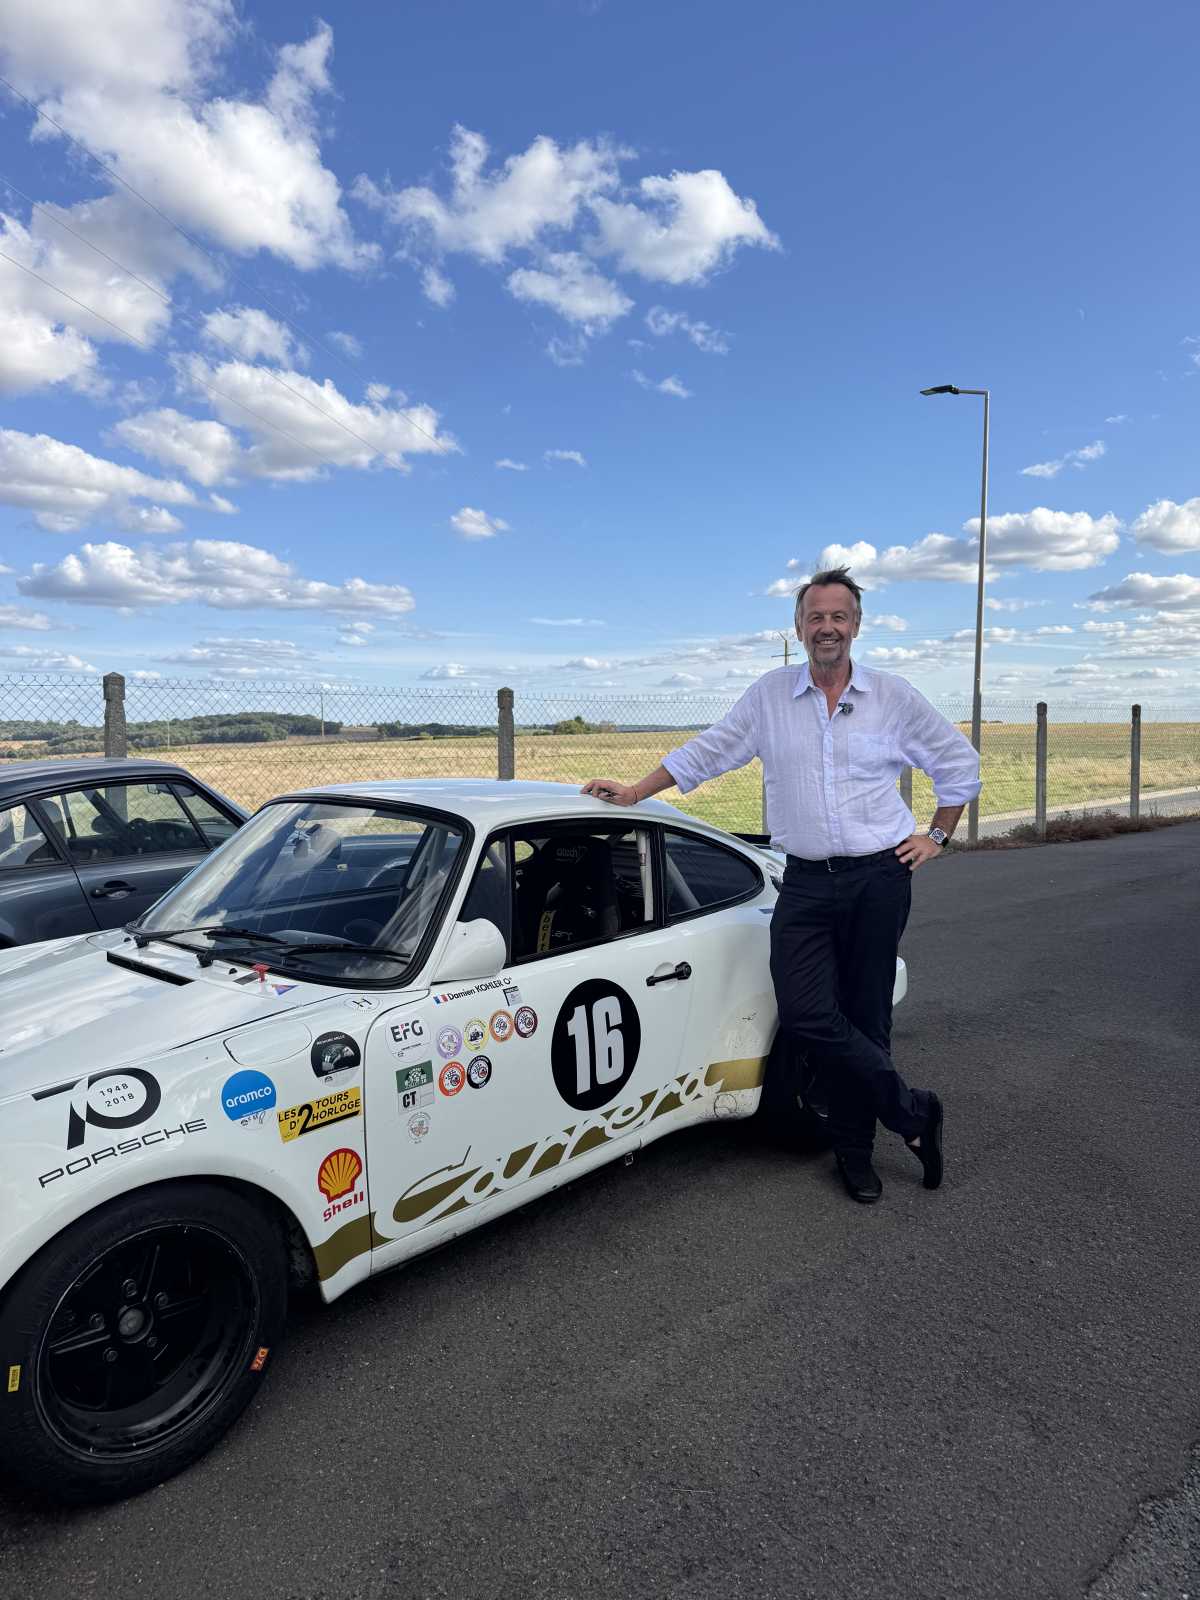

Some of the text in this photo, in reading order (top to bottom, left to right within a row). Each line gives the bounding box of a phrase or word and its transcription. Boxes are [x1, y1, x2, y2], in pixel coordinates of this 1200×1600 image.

[447, 988, 476, 1001] Damien
[475, 979, 503, 993] KOHLER
[390, 1019, 424, 1043] EFG
[567, 995, 625, 1095] 16
[100, 1083, 129, 1097] 1948
[105, 1093, 135, 1108] 2018
[226, 1086, 272, 1108] aramco
[402, 1091, 417, 1109] CT
[31, 1067, 162, 1151] 70
[278, 1109, 297, 1123] LES
[315, 1091, 350, 1109] TOURS
[312, 1098, 361, 1123] HORLOGE
[38, 1118, 208, 1189] PORSCHE
[373, 1063, 725, 1238] Carrera
[323, 1191, 364, 1222] Shell
